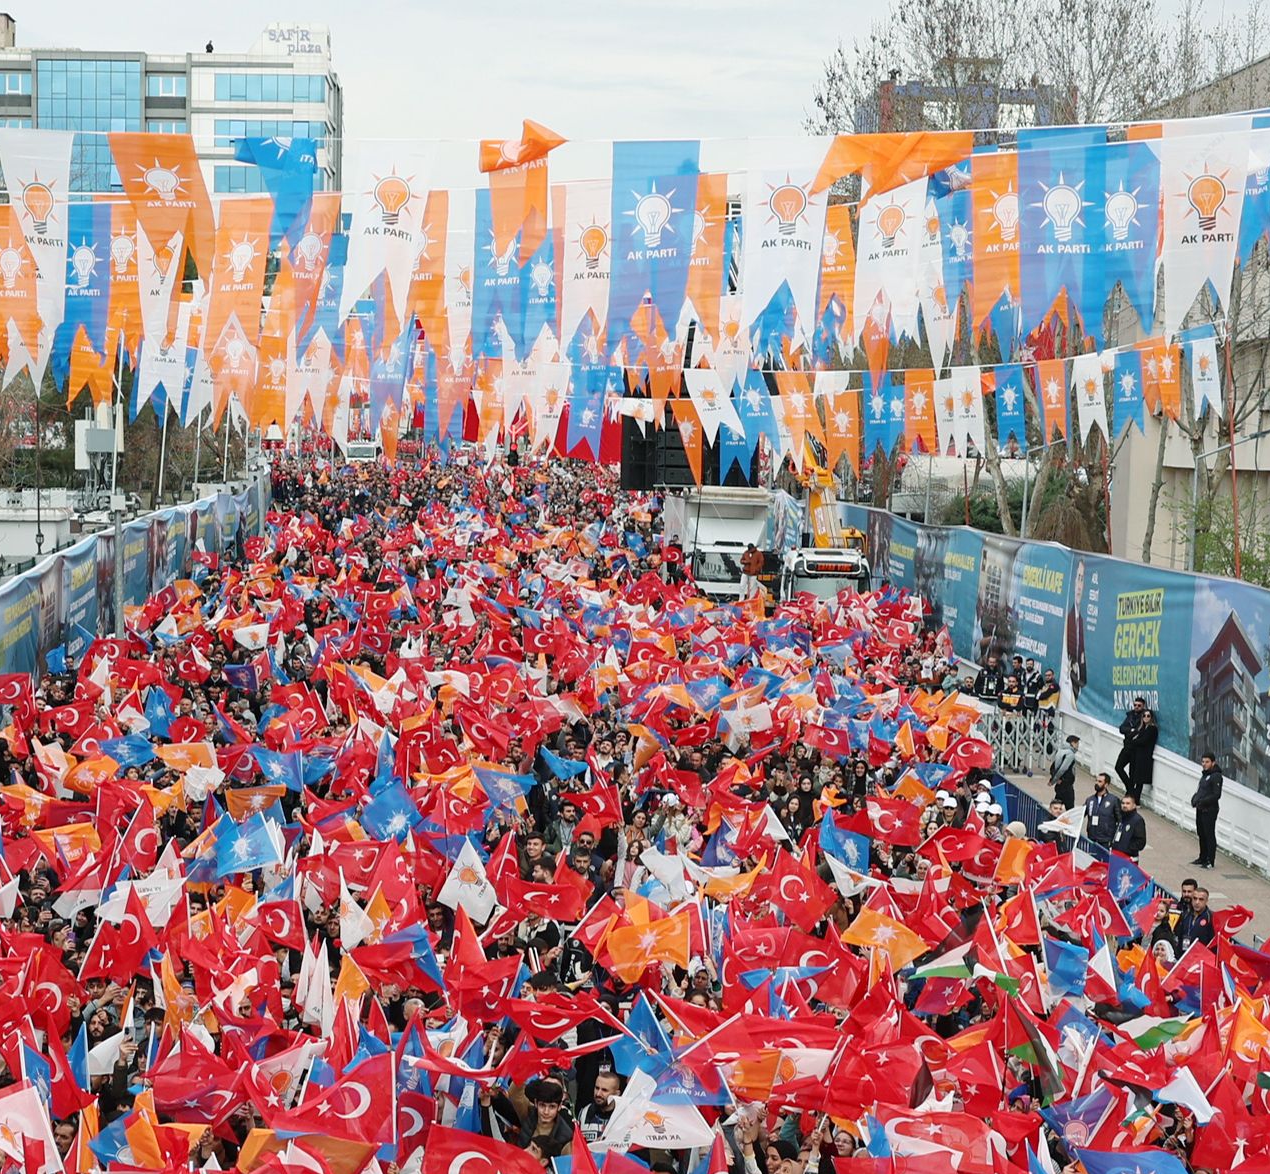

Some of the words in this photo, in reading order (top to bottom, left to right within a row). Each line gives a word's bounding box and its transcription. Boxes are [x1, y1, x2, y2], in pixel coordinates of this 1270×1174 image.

[287, 43, 322, 56] plaza
[520, 158, 549, 172] PART
[363, 227, 379, 237] AK
[23, 236, 36, 245] AK
[761, 239, 779, 250] AK
[1181, 234, 1198, 245] AK
[1003, 242, 1020, 252] PAR
[1037, 244, 1055, 254] AK
[1105, 243, 1114, 251] K
[627, 251, 644, 261] AK
[868, 253, 880, 261] AK
[587, 271, 611, 281] PART
[220, 284, 231, 292] AK
[484, 279, 497, 287] AK
[67, 288, 78, 297] AK
[149, 288, 161, 296] AK
[1114, 620, 1162, 662] GERÇEK
